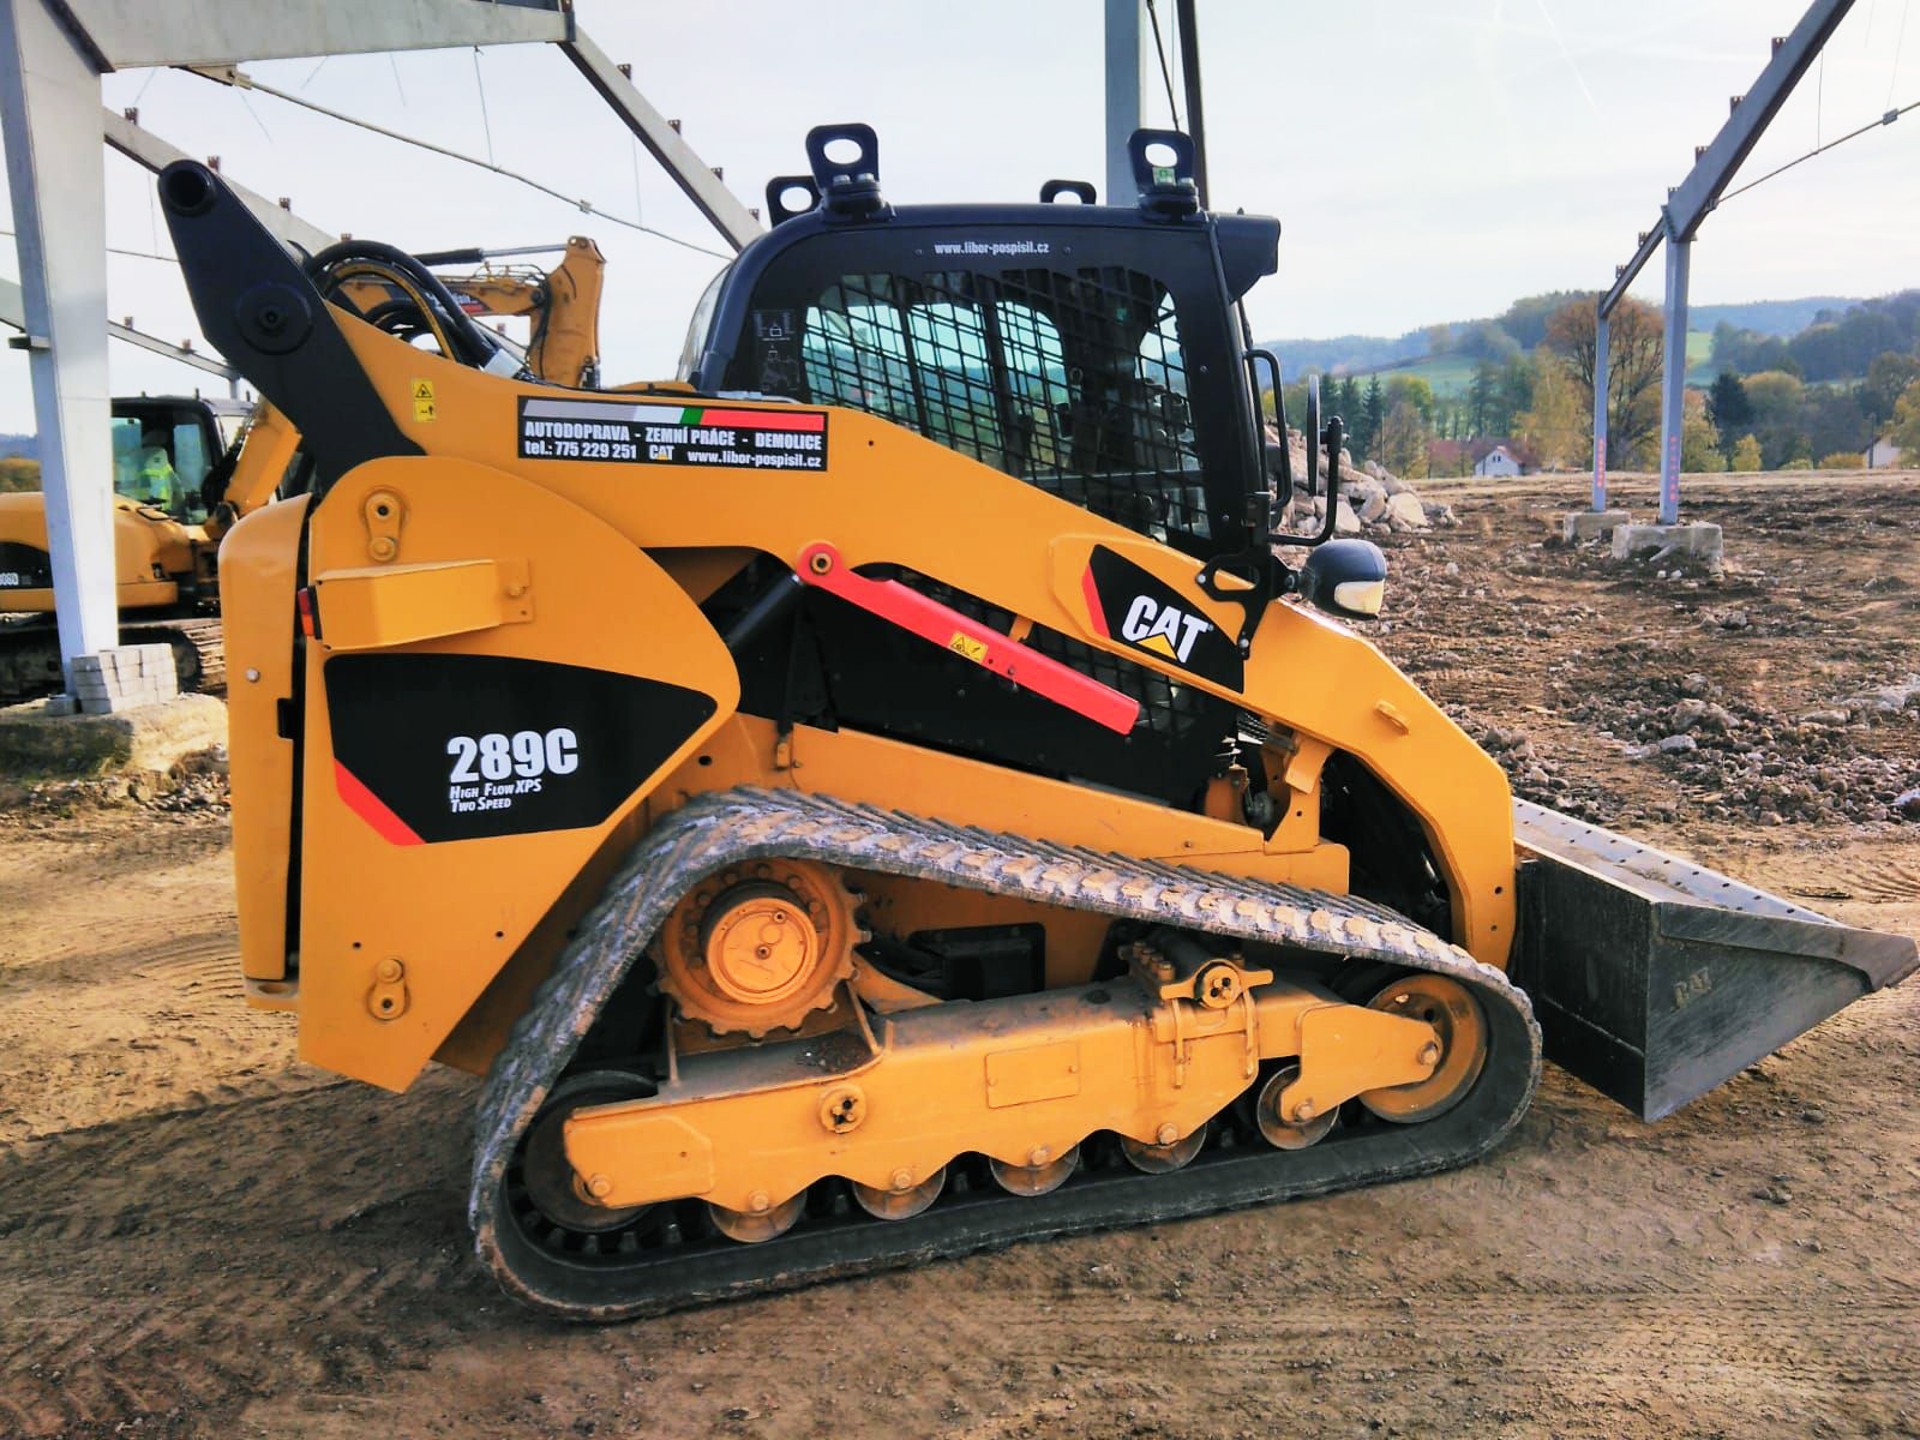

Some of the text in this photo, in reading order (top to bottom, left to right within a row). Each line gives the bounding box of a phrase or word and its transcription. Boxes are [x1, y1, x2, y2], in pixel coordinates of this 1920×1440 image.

[934, 241, 1050, 255] www.libor-pospisil.cz
[525, 421, 630, 441] AUTODOPRAVA
[645, 426, 688, 444] ZEMNÍ
[691, 427, 736, 447] PRÁCE
[755, 432, 822, 451] DEMOLICE
[555, 441, 580, 457] 775
[582, 442, 610, 458] 229
[612, 443, 637, 459] 251
[649, 444, 674, 460] CAT
[687, 450, 822, 468] www.libor-pospisil.cz
[1122, 595, 1209, 663] CAT
[447, 728, 578, 783] 289C
[515, 778, 543, 794] XPS
